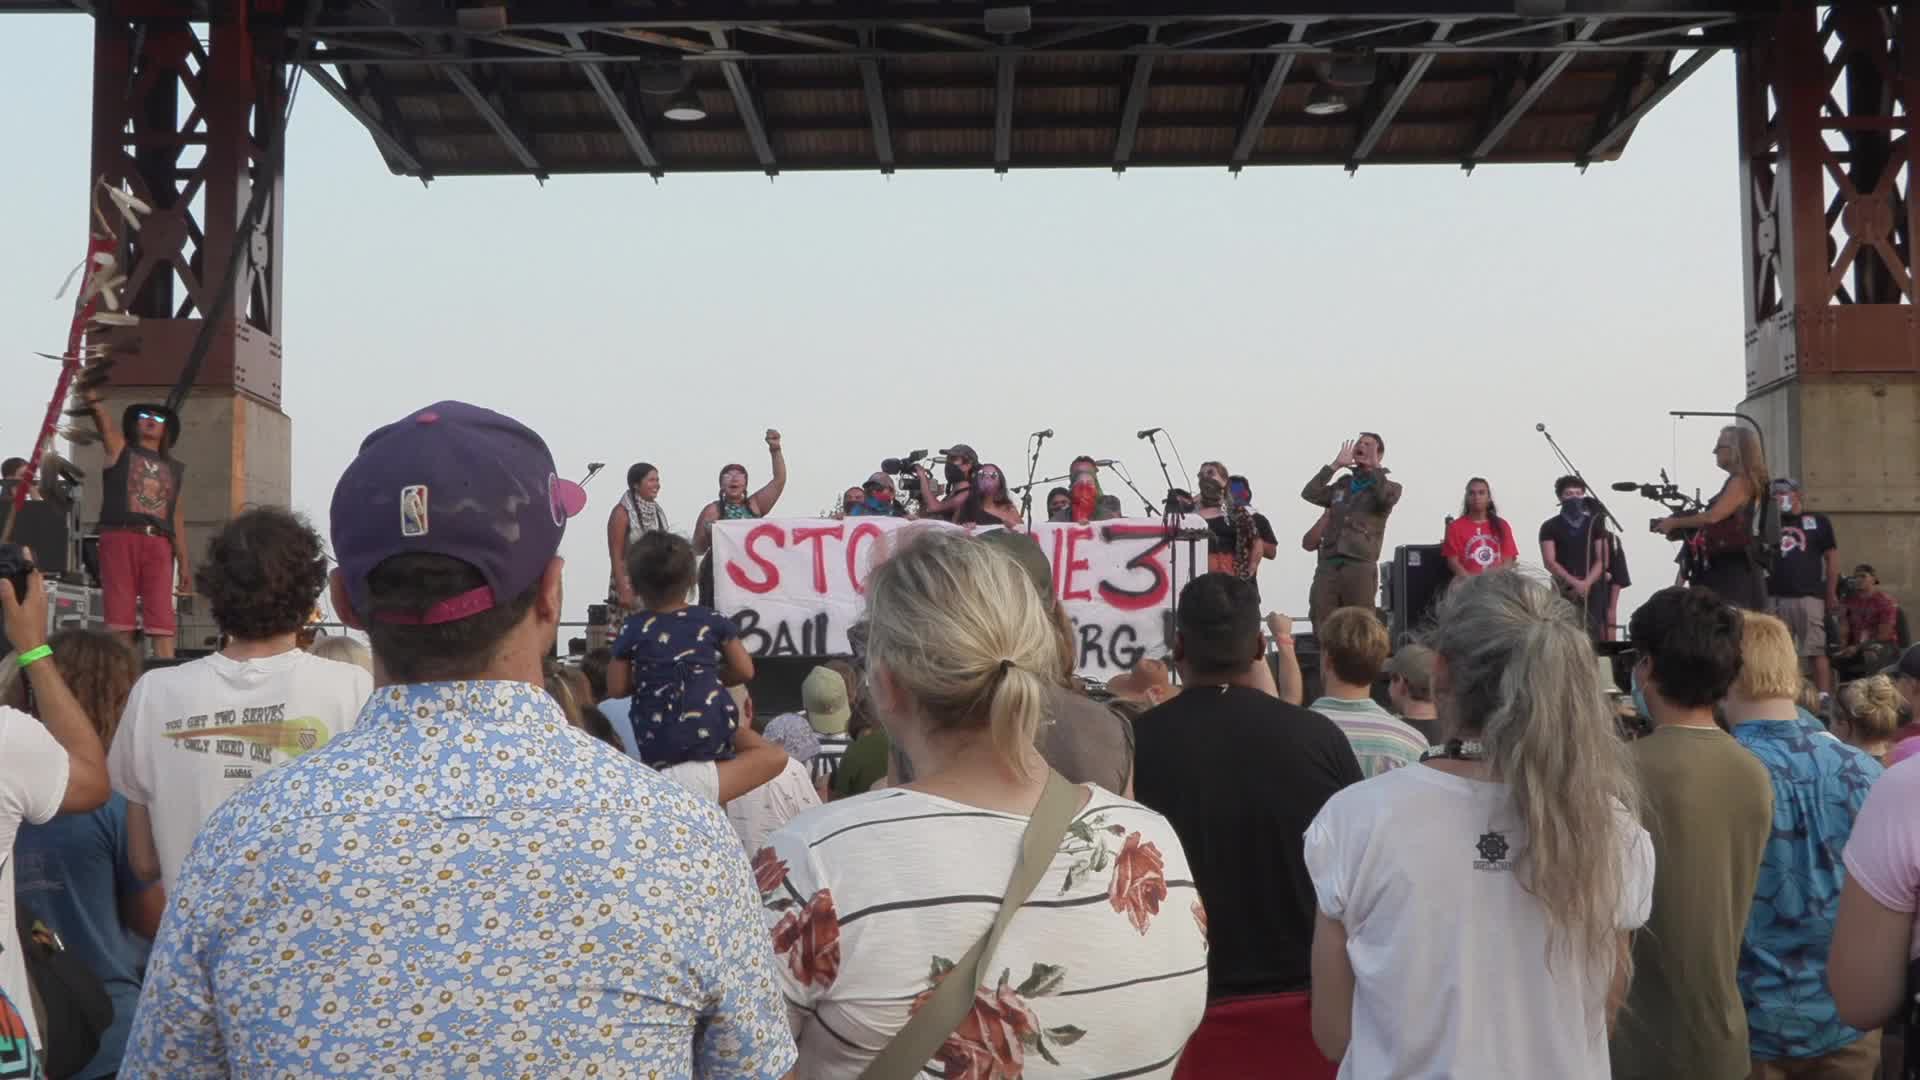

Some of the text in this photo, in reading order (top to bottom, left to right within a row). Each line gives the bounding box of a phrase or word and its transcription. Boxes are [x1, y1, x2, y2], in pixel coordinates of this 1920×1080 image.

[726, 523, 883, 595] STO
[165, 703, 285, 730] YOU GET TWO SERVES
[184, 738, 209, 754] ONLY
[216, 739, 244, 758] NEED
[250, 742, 272, 764] ONE
